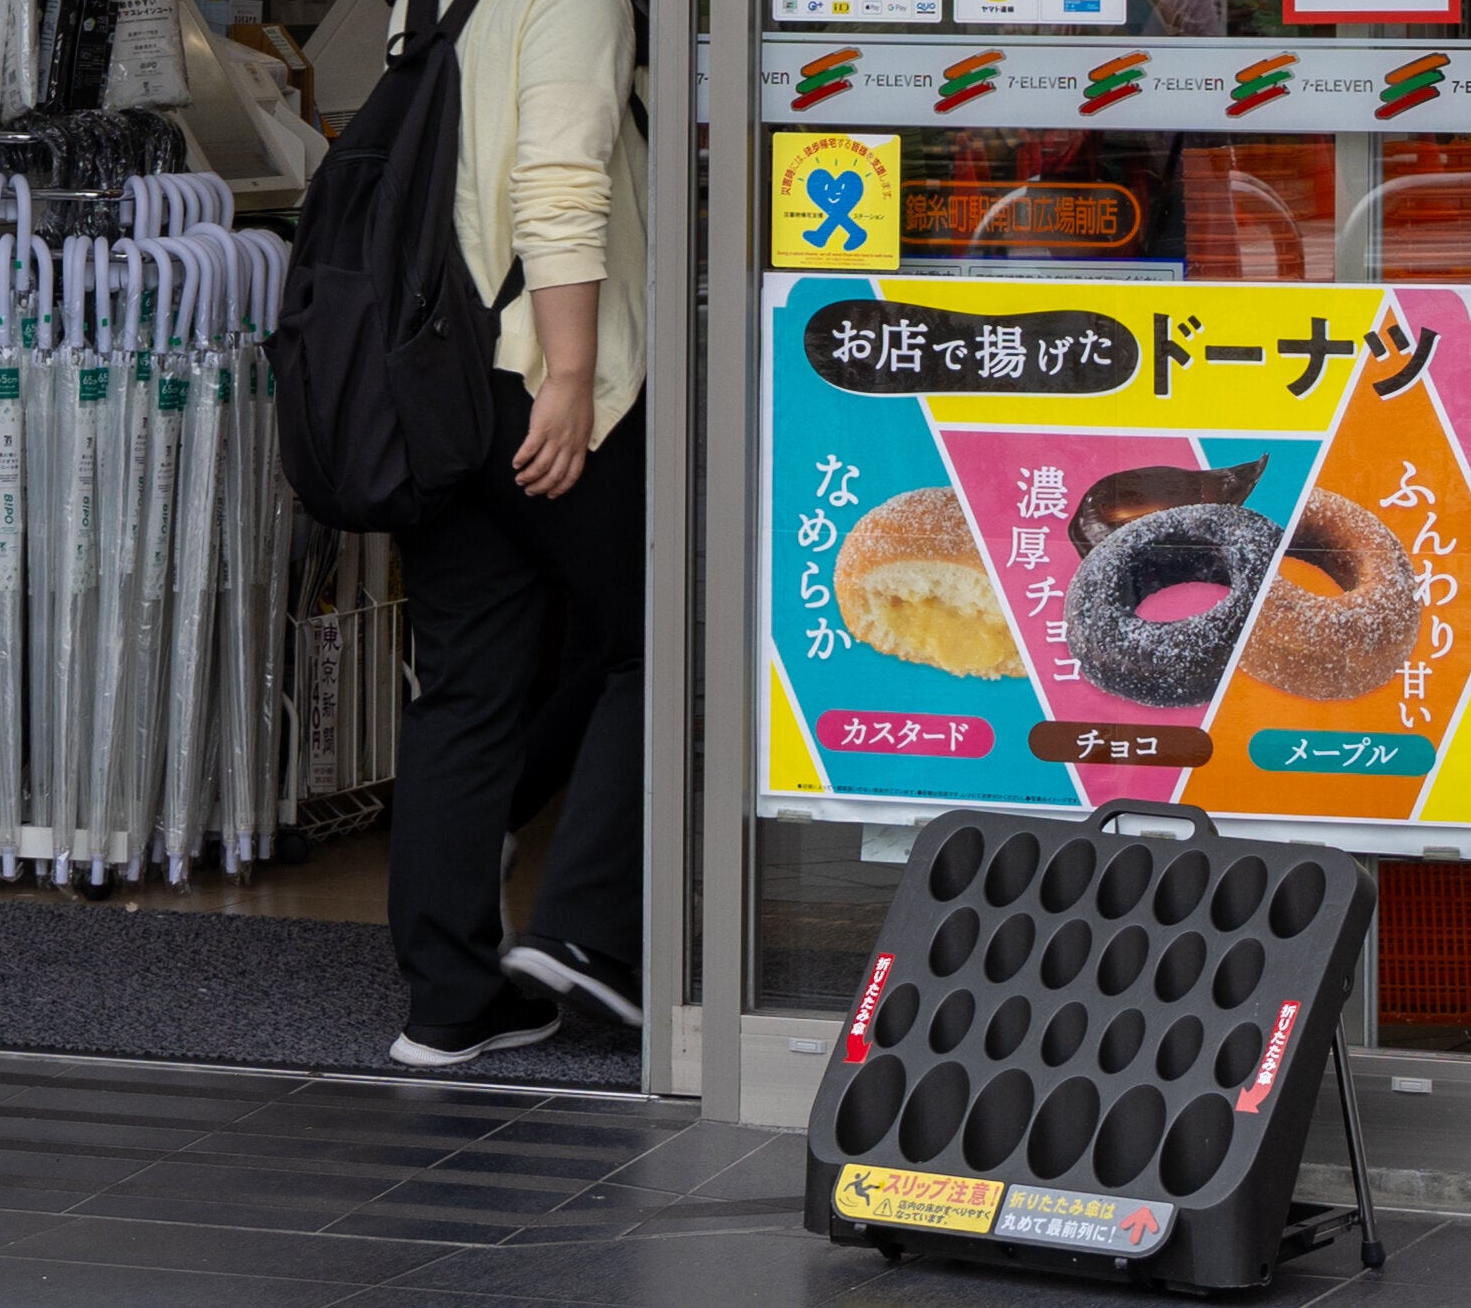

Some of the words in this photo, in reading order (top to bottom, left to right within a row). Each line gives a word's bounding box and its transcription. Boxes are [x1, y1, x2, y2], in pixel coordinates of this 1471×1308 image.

[904, 194, 1119, 237] 錦糸町駅南口広場前店
[831, 317, 1113, 379] お店で揚げた
[1152, 308, 1442, 400] ドーナツ
[796, 452, 862, 660] なめらか
[1006, 466, 1084, 683] 濃厚チョコ
[1379, 460, 1459, 729] ふんわり甘い
[321, 622, 341, 756] 東京新聞
[841, 716, 970, 749] カスタード
[1075, 729, 1159, 758] チョコ
[1283, 737, 1399, 767] メープル
[849, 956, 892, 1035] 折りたたみ傘
[1256, 1002, 1297, 1085] 折りたたみ傘
[881, 1172, 1002, 1207] スリップ注意!
[1008, 1191, 1118, 1220] 折りたたみ傘は
[895, 1210, 950, 1225] なっています。
[897, 1199, 992, 1220] 店内の床がすべりやすく
[1001, 1212, 1119, 1244] 丸めて最前列に!
